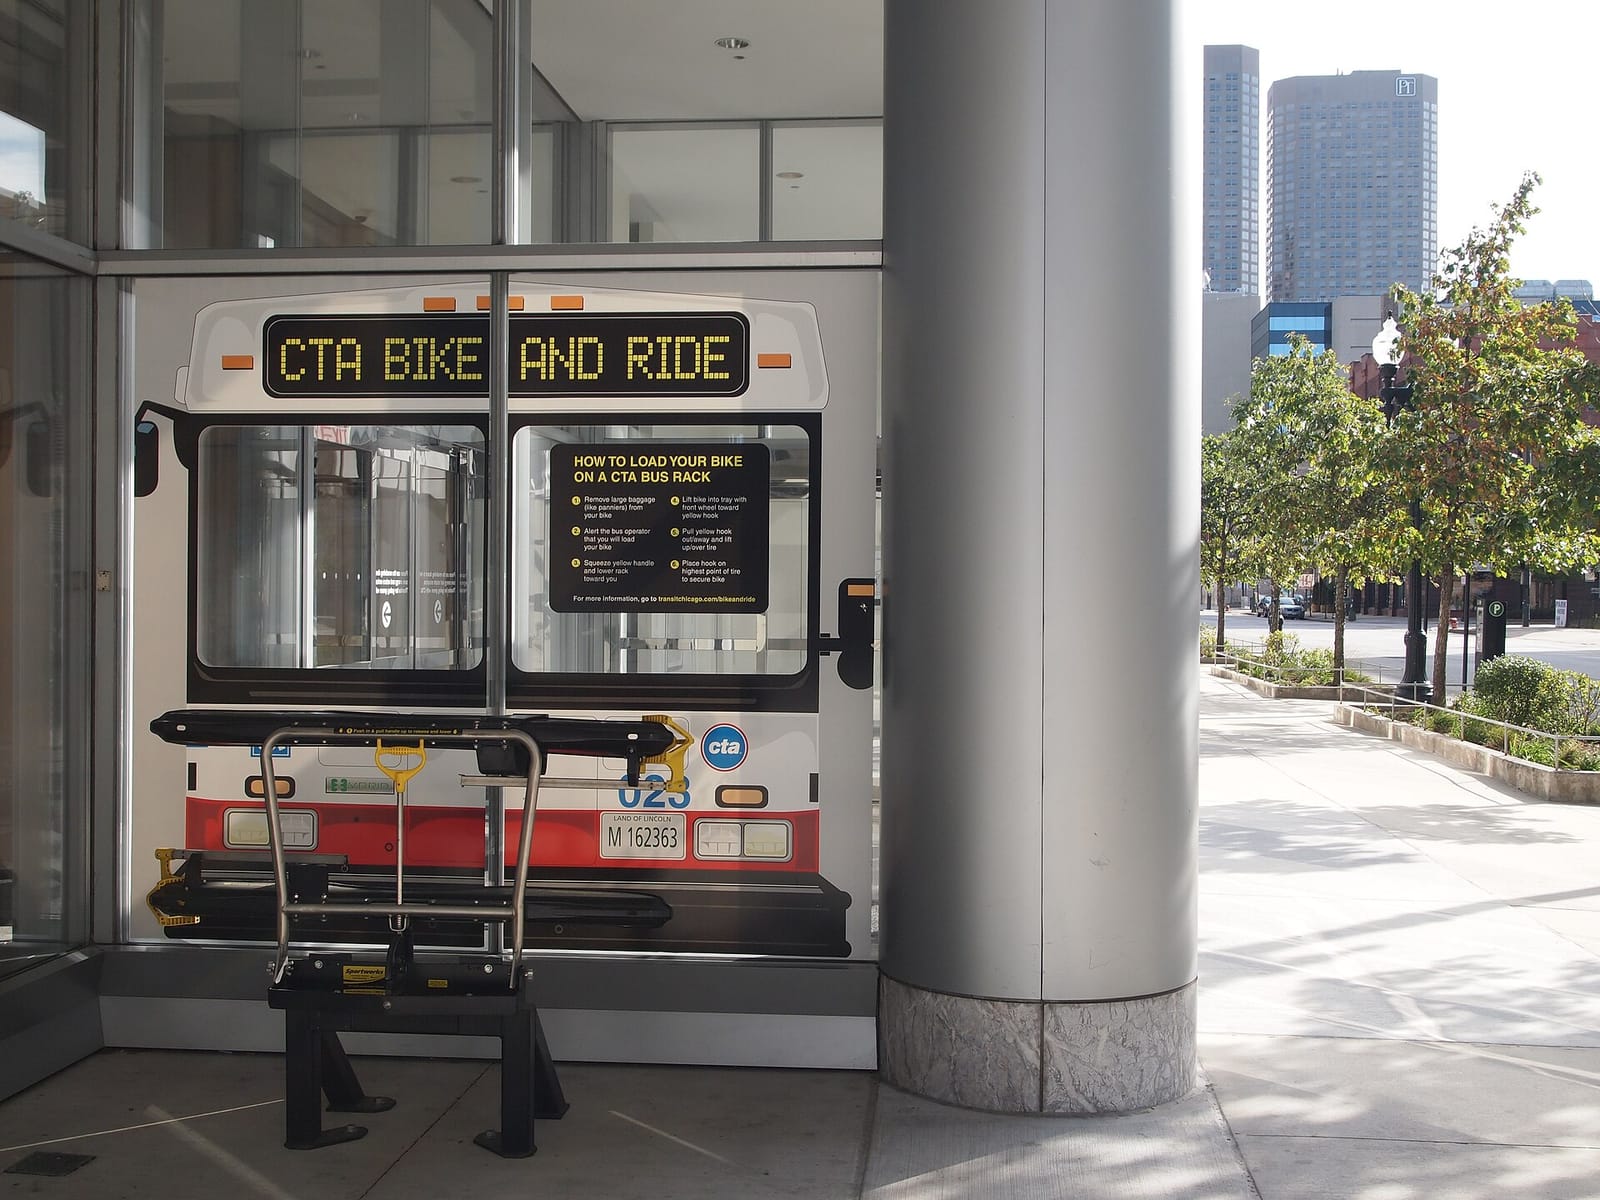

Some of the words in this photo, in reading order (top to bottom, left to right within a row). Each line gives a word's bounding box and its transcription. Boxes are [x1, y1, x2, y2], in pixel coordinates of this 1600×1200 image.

[281, 338, 361, 381] CTA
[385, 337, 483, 380] BIKE
[521, 337, 603, 380] AND
[627, 336, 730, 380] RIDE
[574, 456, 606, 467] HOW
[608, 456, 626, 467] TO
[630, 456, 667, 467] LOAD
[670, 456, 707, 467] YOUR
[711, 456, 743, 467] BIKE
[574, 471, 594, 482] ON
[598, 471, 607, 482] A
[611, 471, 637, 482] CTA
[641, 471, 669, 482] BUS
[673, 471, 711, 482] RACK
[708, 739, 740, 755] cta
[609, 827, 621, 847] M
[628, 827, 677, 847] 162363
